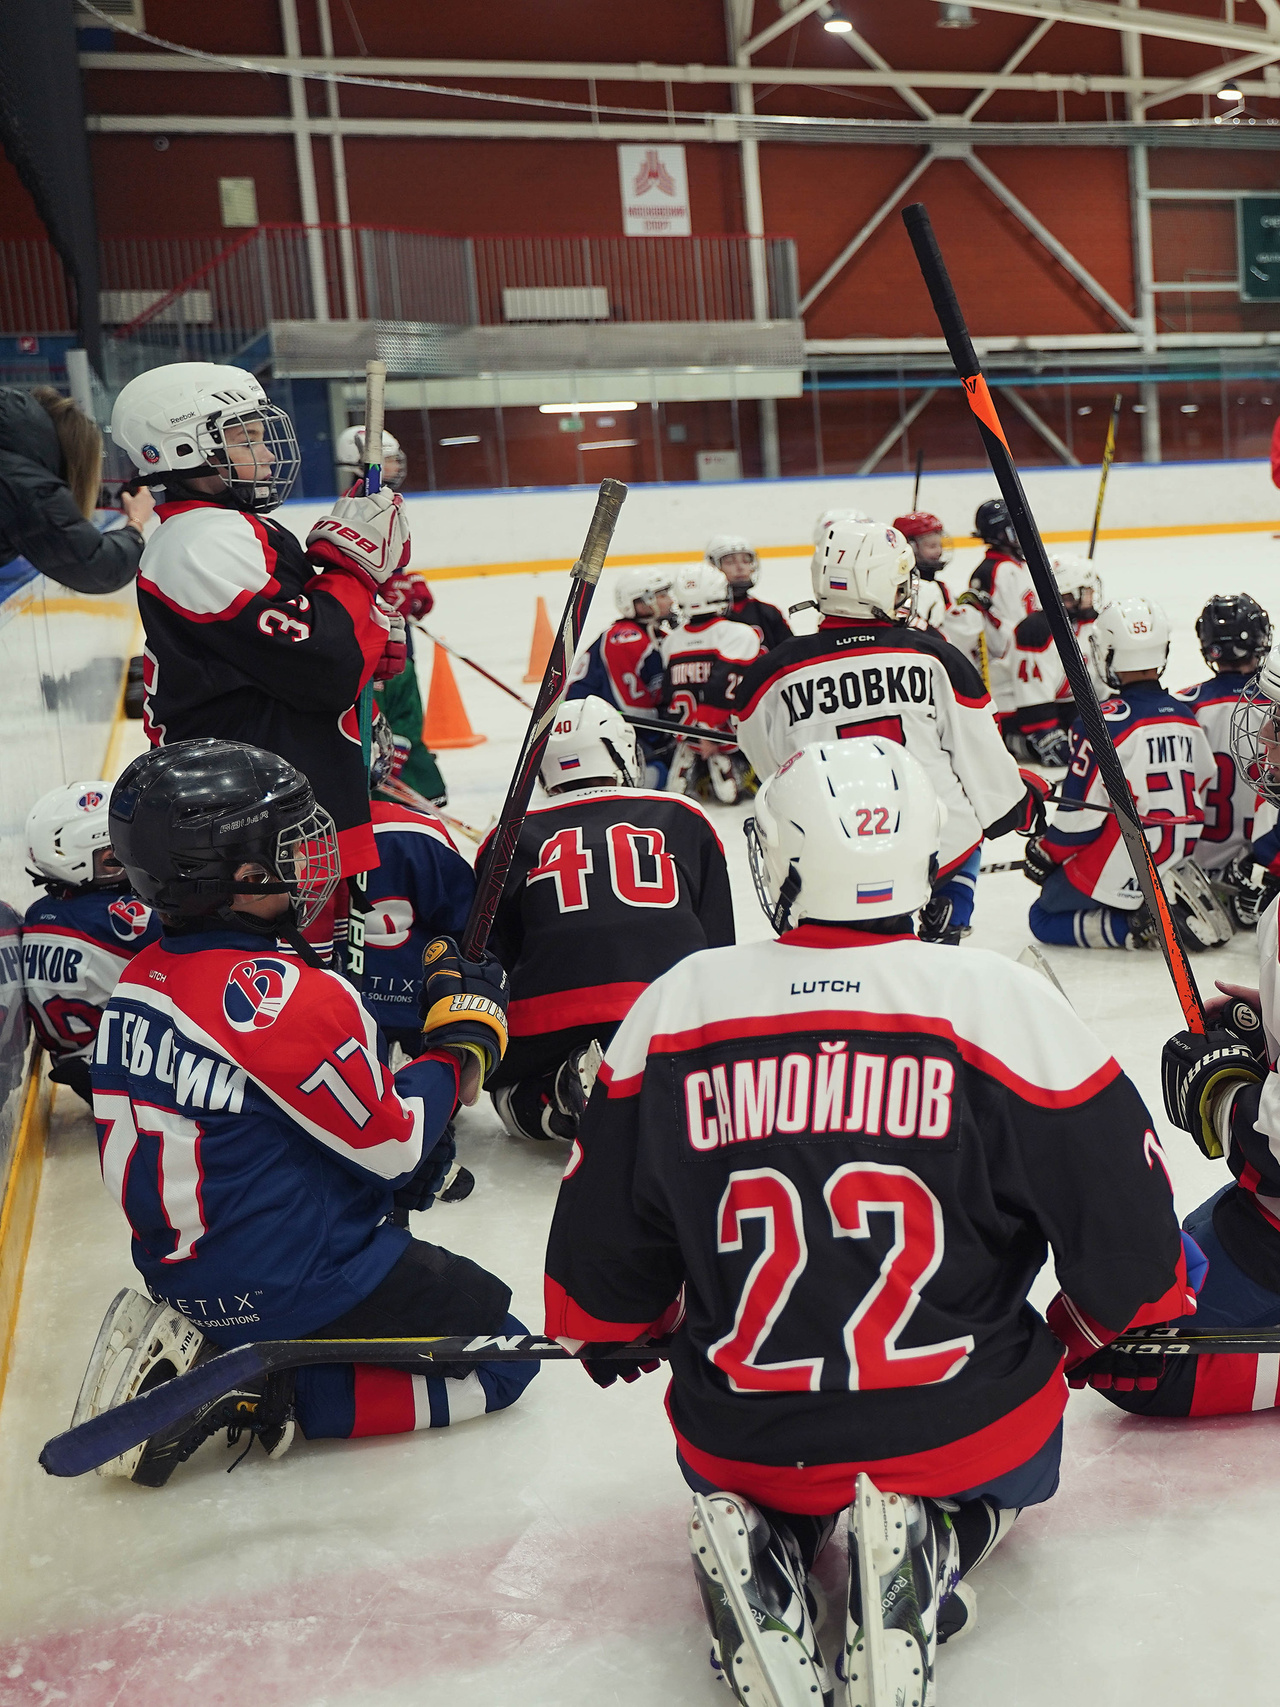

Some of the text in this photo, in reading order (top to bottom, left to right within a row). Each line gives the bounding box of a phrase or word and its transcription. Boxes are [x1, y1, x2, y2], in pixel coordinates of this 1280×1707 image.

[170, 411, 197, 426] Reebok
[835, 549, 846, 565] 7
[1132, 621, 1148, 634] 55
[836, 634, 876, 646] LUTCH
[555, 720, 572, 735] 40
[855, 807, 893, 836] 22
[526, 822, 679, 915] 40
[22, 944, 84, 983] ЧКОВ
[790, 979, 862, 996] LUTCH
[368, 992, 413, 1003] SOLUTIONS
[300, 1037, 384, 1130] 77
[683, 1039, 956, 1153] САМОЙЛОВ
[92, 1090, 208, 1264] 77
[705, 1160, 976, 1394] 22
[205, 1313, 261, 1328] SOLUTIONS
